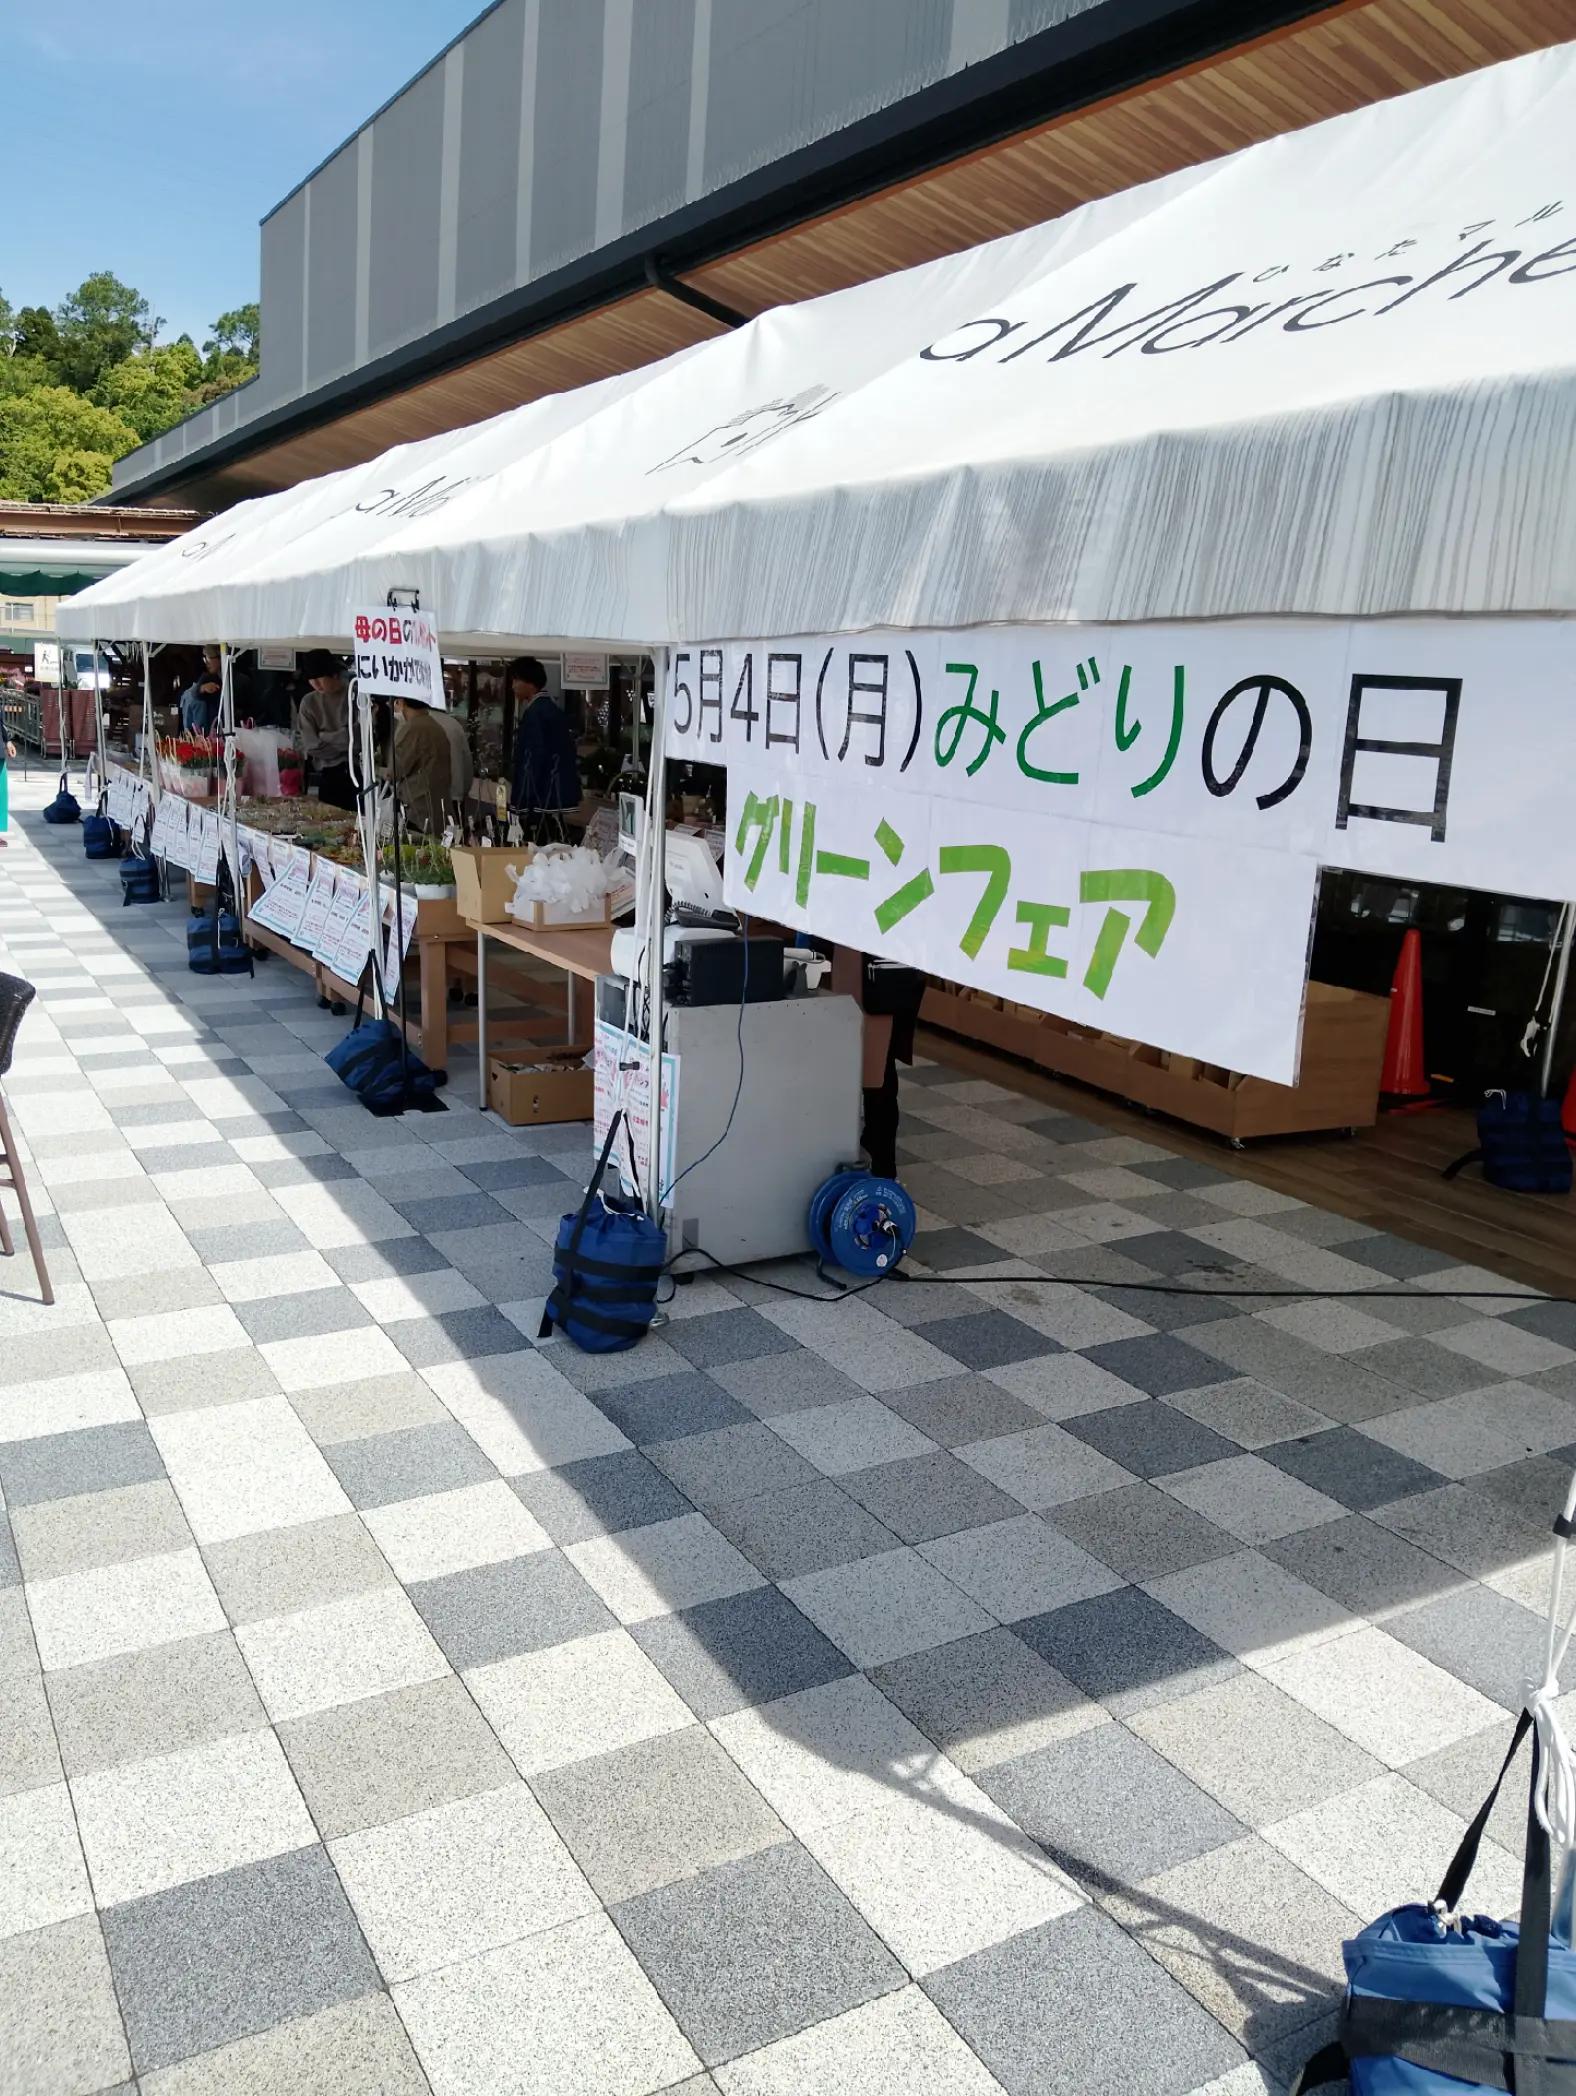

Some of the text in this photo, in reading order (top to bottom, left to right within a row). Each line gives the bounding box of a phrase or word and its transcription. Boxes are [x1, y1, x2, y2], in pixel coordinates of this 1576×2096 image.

[674, 647, 1463, 842] 5月4日(月)みどりの日
[736, 791, 1176, 1000] グリーンフェア
